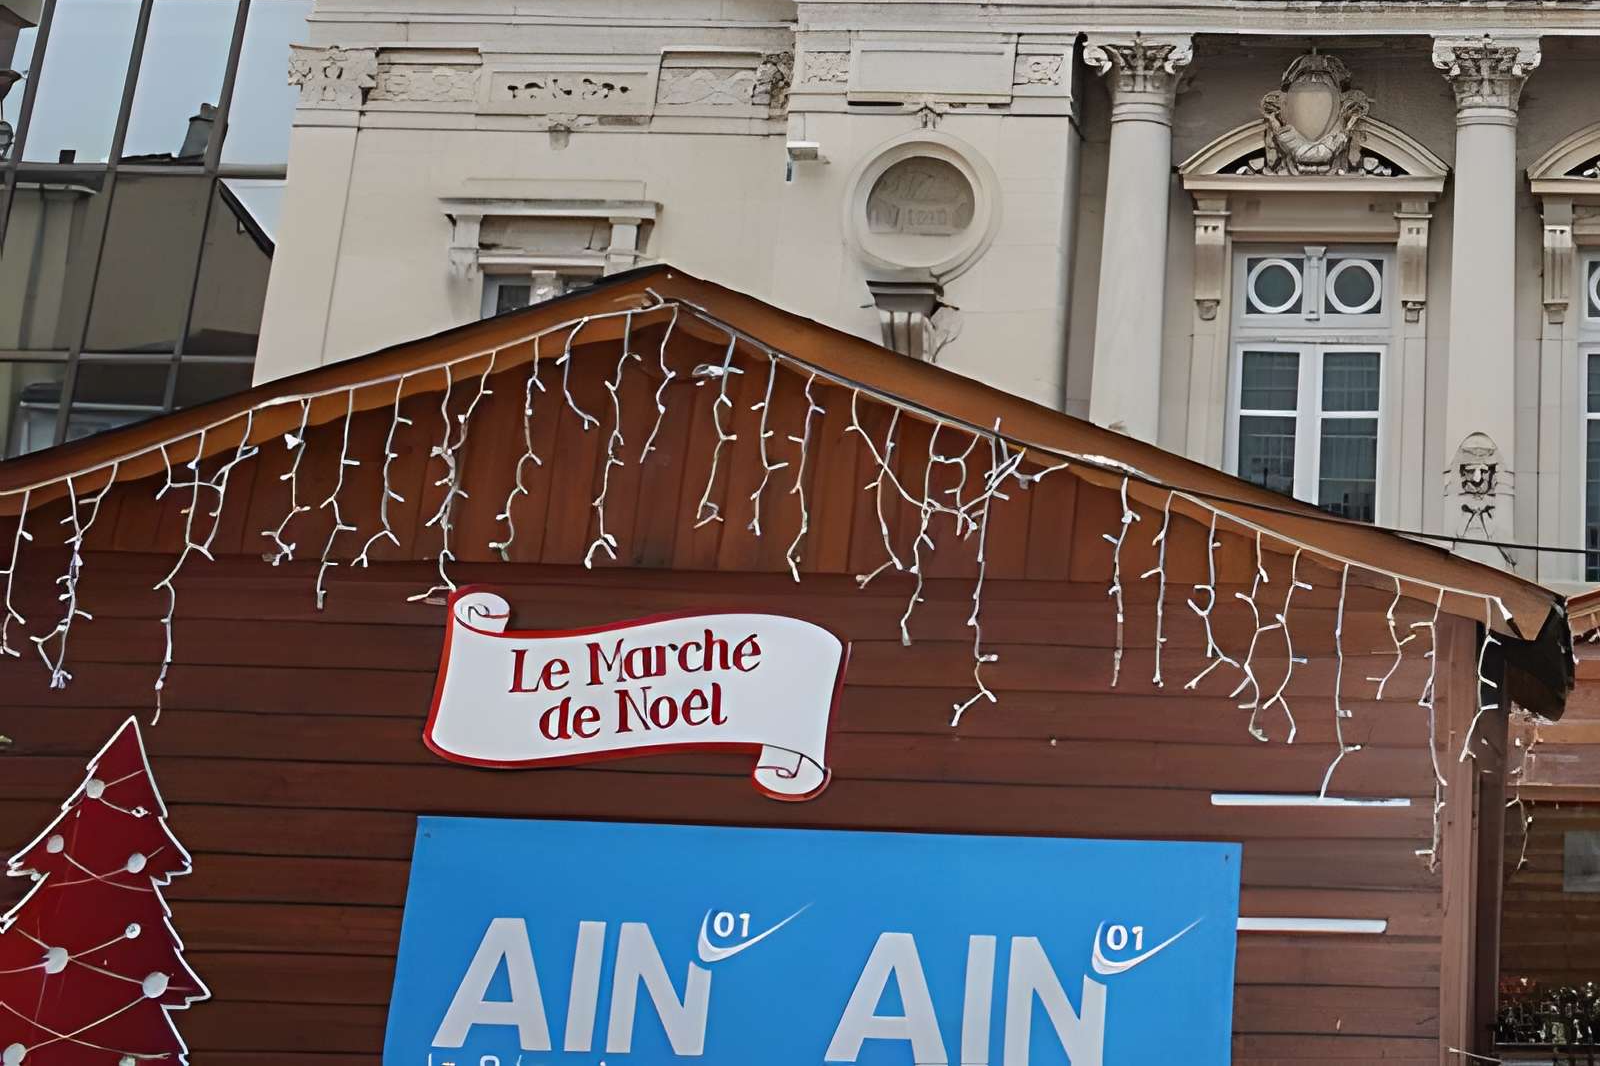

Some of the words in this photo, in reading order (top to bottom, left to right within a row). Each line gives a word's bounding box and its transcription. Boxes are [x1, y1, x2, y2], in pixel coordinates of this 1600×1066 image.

[508, 648, 570, 693] Le
[586, 628, 762, 687] Marché
[538, 696, 601, 741] de
[431, 917, 712, 1056] AIN
[713, 911, 750, 938] 01
[824, 932, 1107, 1066] AIN
[1106, 924, 1145, 952] 01
